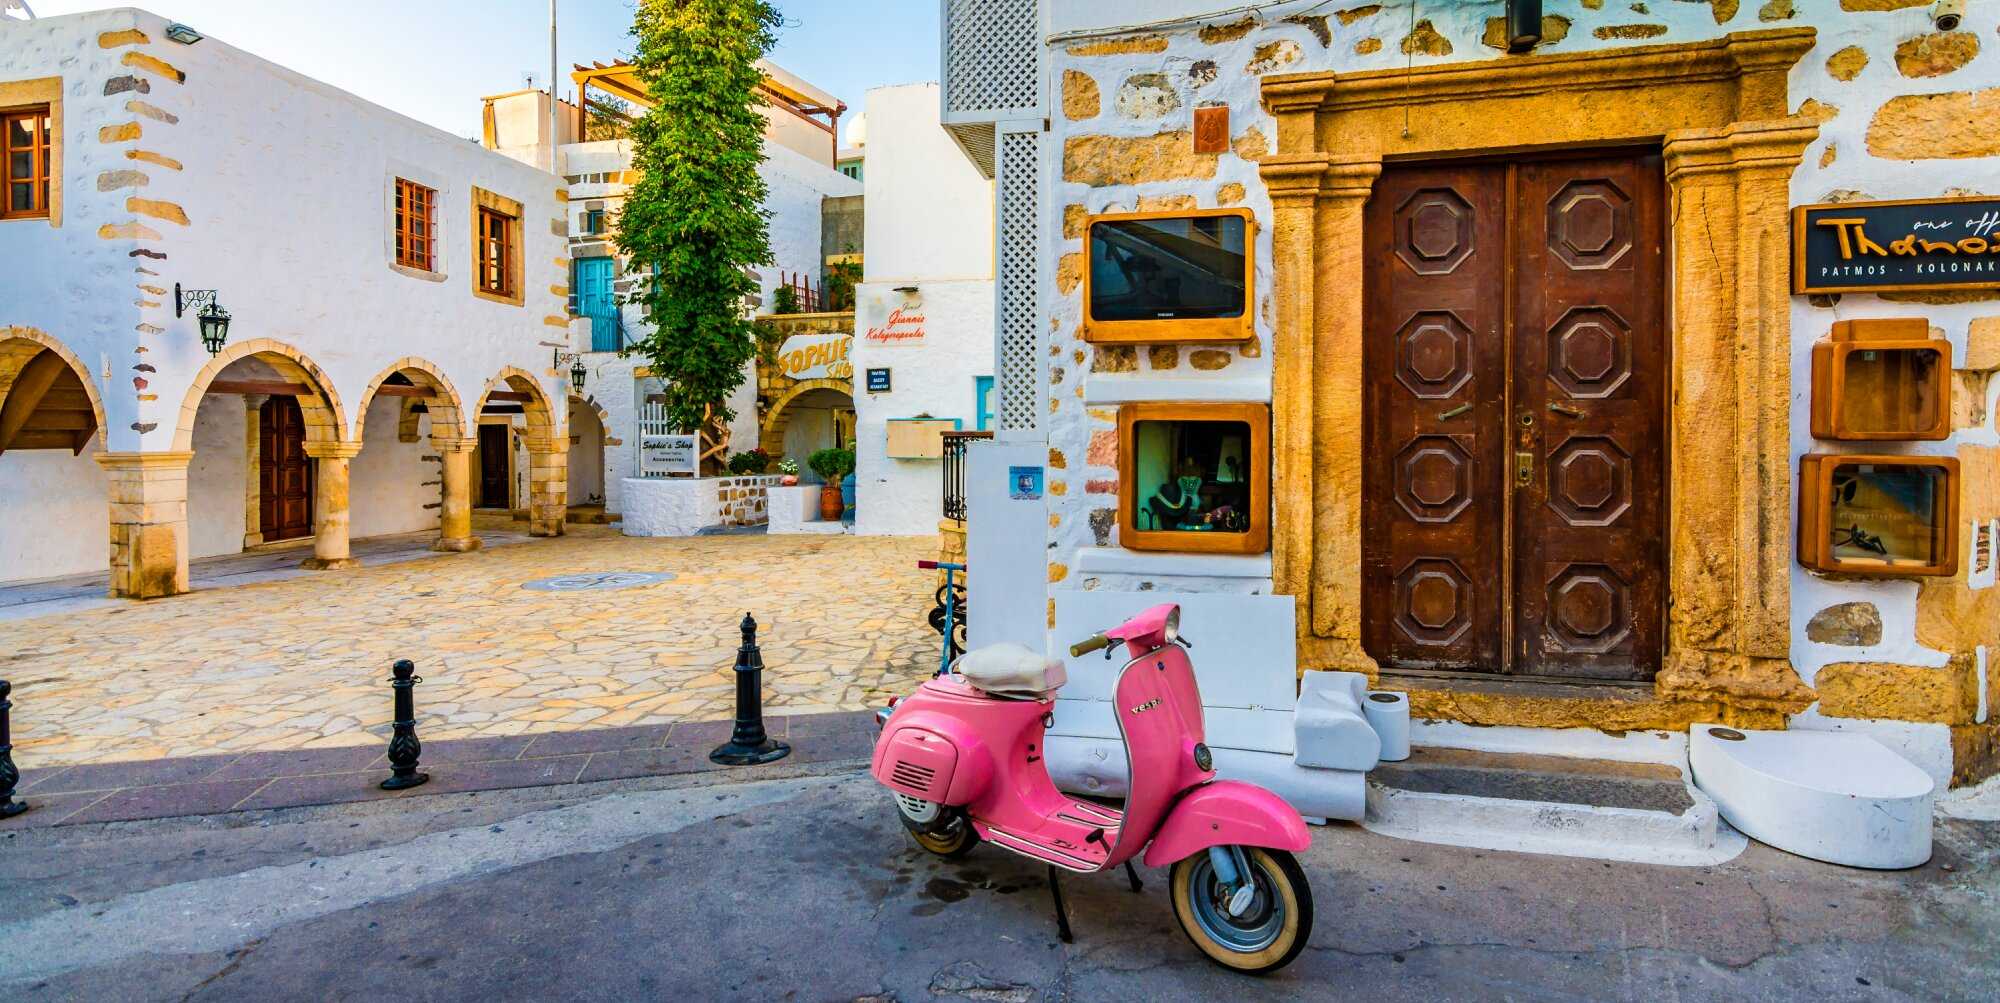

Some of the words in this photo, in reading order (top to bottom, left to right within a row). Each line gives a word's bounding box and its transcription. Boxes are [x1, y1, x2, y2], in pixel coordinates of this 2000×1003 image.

[1913, 221, 1952, 230] one
[1822, 265, 1886, 277] PATMOS
[1917, 261, 1995, 273] KOLONAK
[643, 440, 672, 450] Sophie's
[675, 440, 693, 450] Shop
